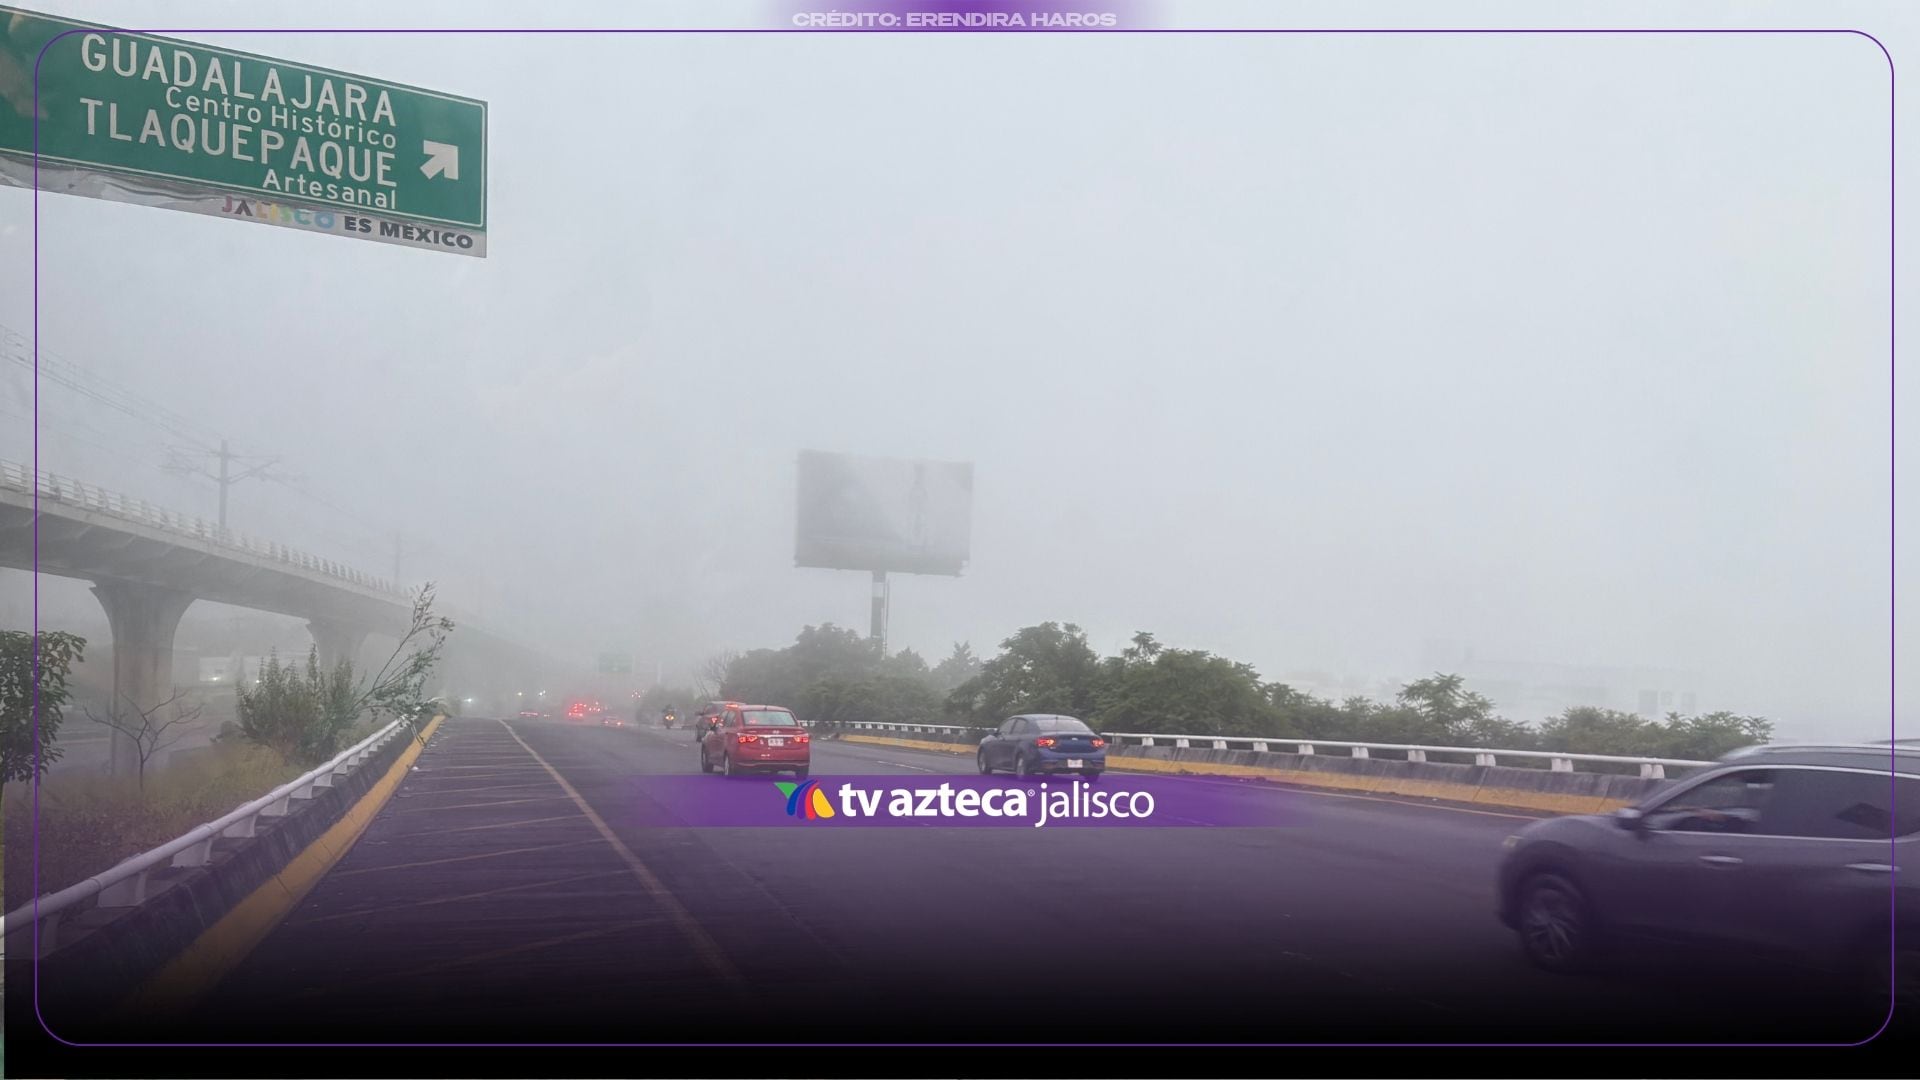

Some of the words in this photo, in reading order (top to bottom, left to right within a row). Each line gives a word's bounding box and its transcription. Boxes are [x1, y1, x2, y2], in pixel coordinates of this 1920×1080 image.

[80, 33, 397, 127] GUADALAJARA
[79, 97, 397, 187] TLAQUEPAQUE
[165, 85, 262, 125] Centro
[270, 106, 397, 149] Histórico
[261, 169, 397, 210] Artesanal
[221, 195, 335, 230] JALISCO
[344, 216, 372, 233] ES
[379, 221, 474, 250] MÉXICO
